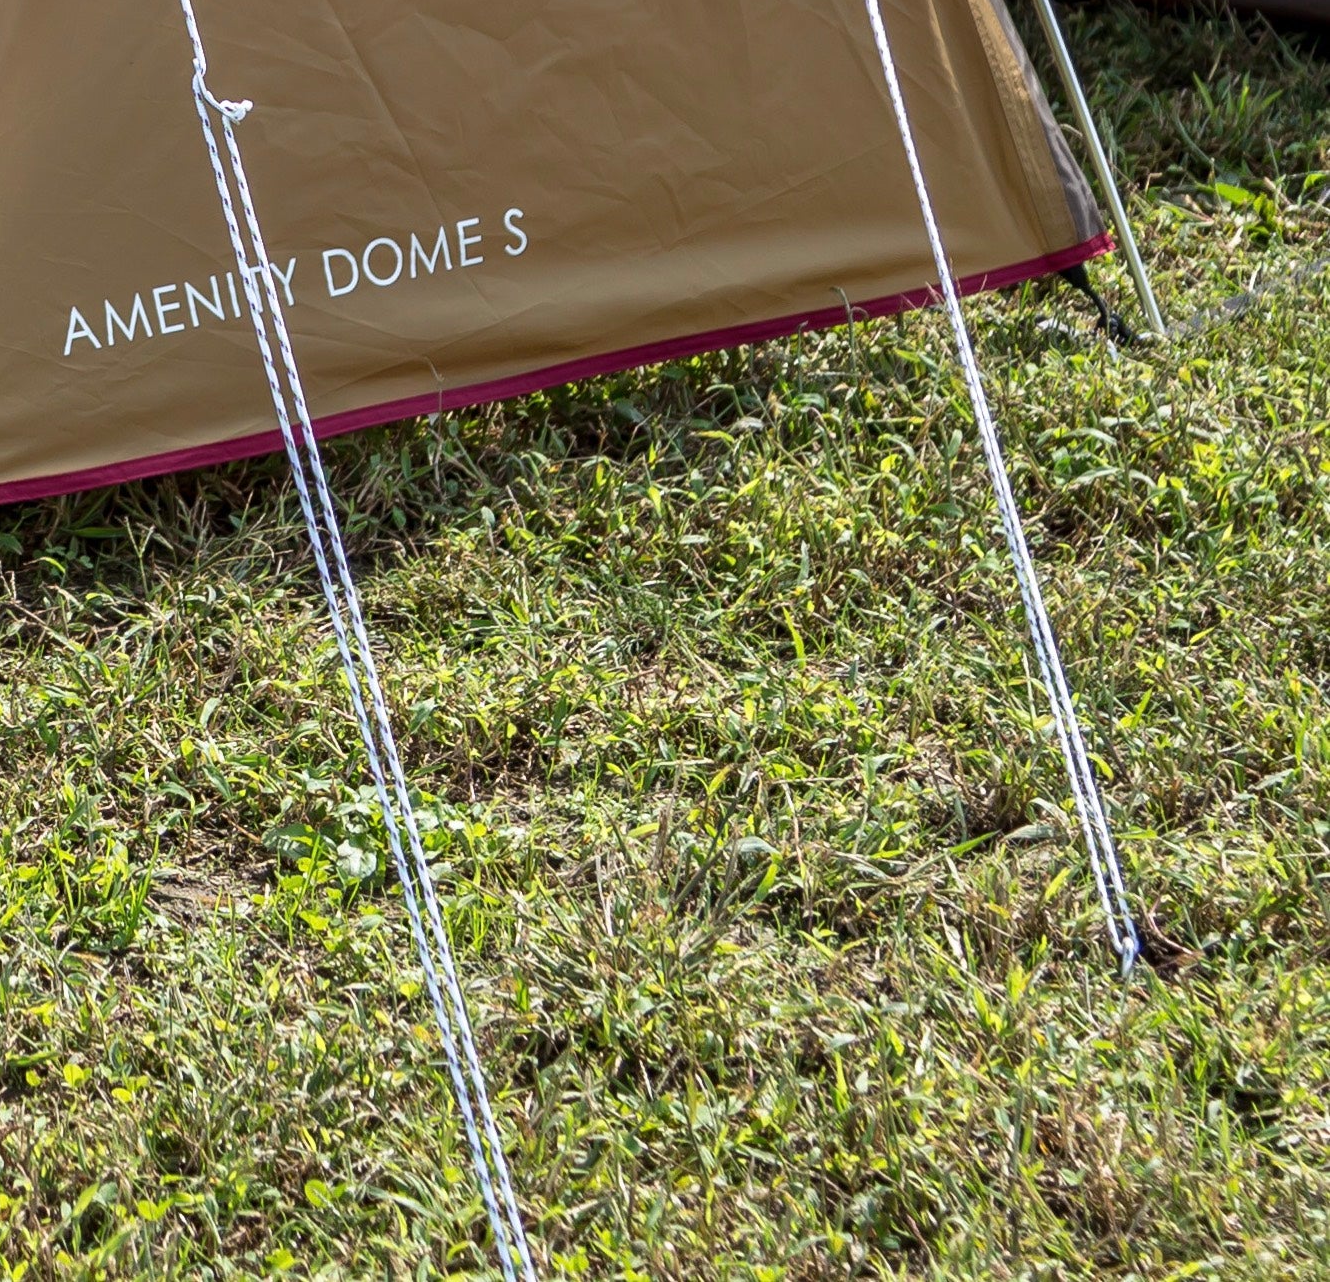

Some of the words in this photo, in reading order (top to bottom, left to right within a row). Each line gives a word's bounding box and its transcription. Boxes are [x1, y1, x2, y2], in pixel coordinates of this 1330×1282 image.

[63, 256, 298, 356] AMENITY
[322, 216, 485, 298] DOME
[503, 206, 530, 257] S
